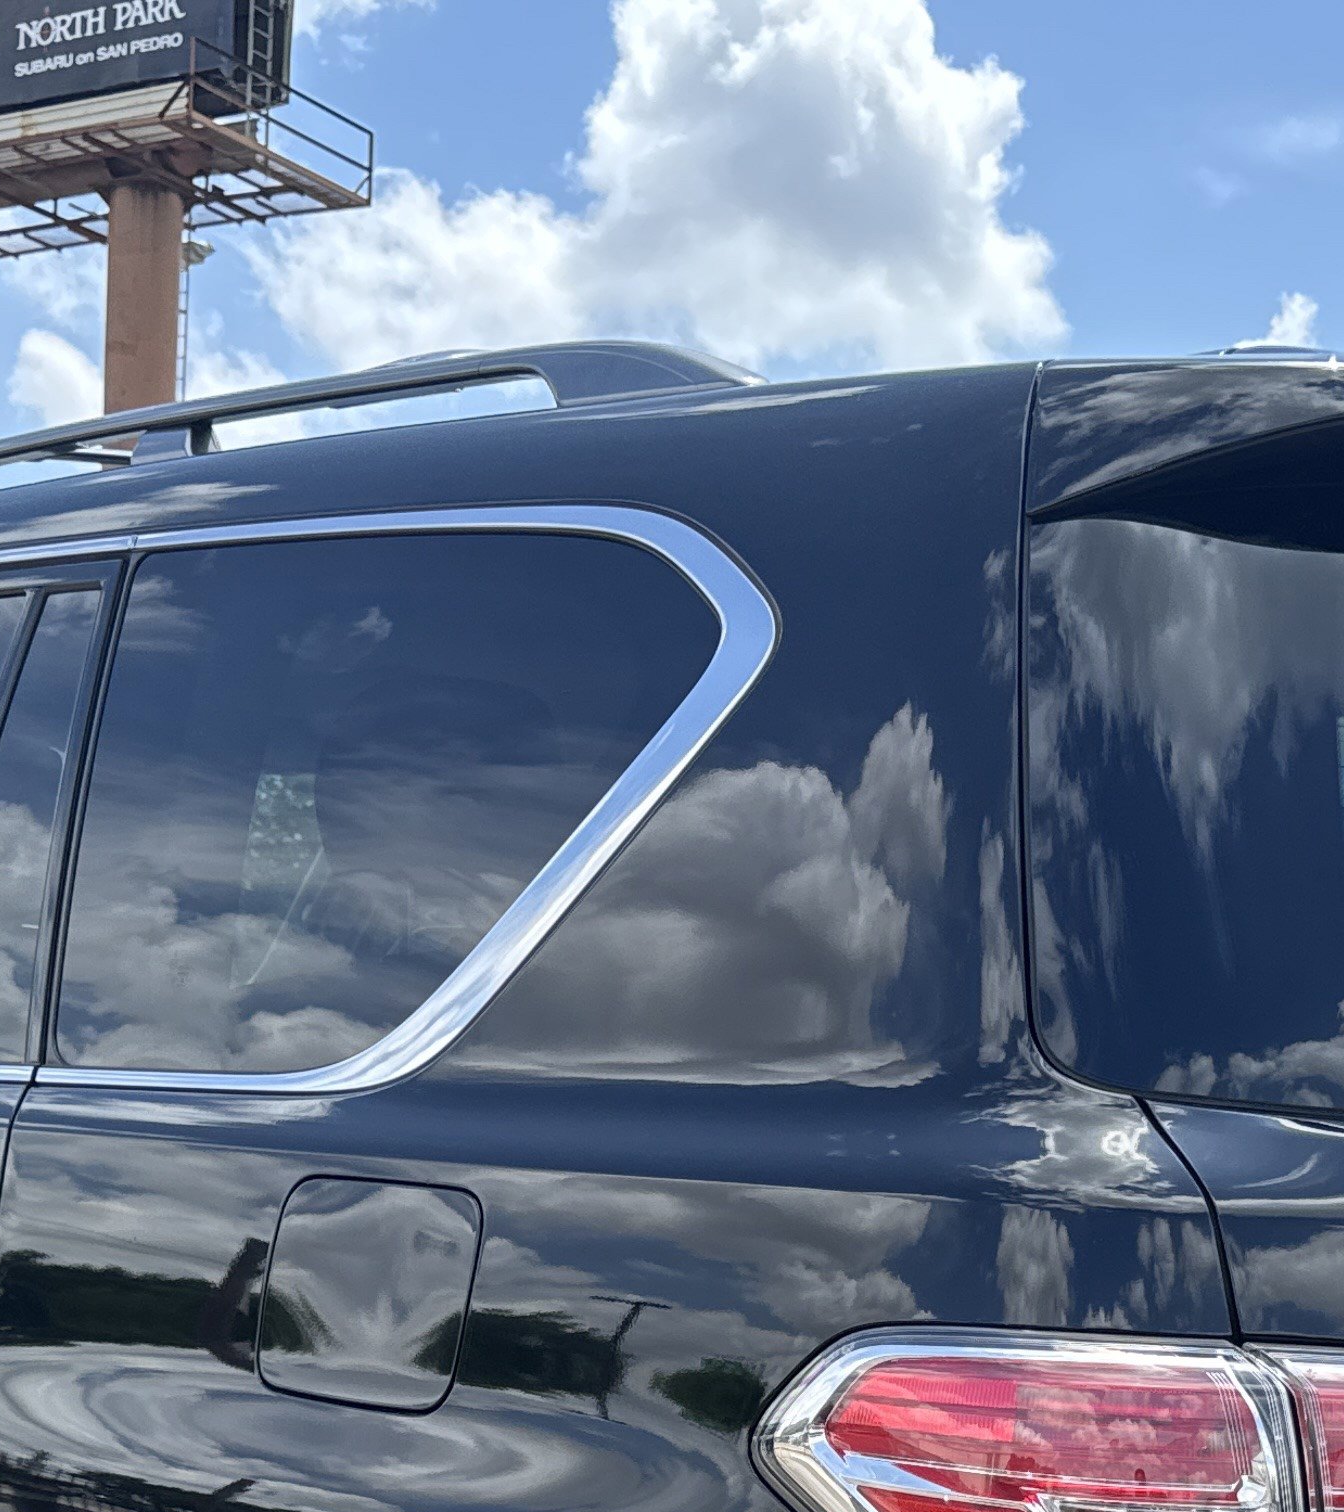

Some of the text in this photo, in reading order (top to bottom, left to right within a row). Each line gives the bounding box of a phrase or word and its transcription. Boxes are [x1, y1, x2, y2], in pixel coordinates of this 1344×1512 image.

[15, 0, 187, 51] NORTH PARK
[14, 31, 185, 78] SUBARU on SAN PEDRO
